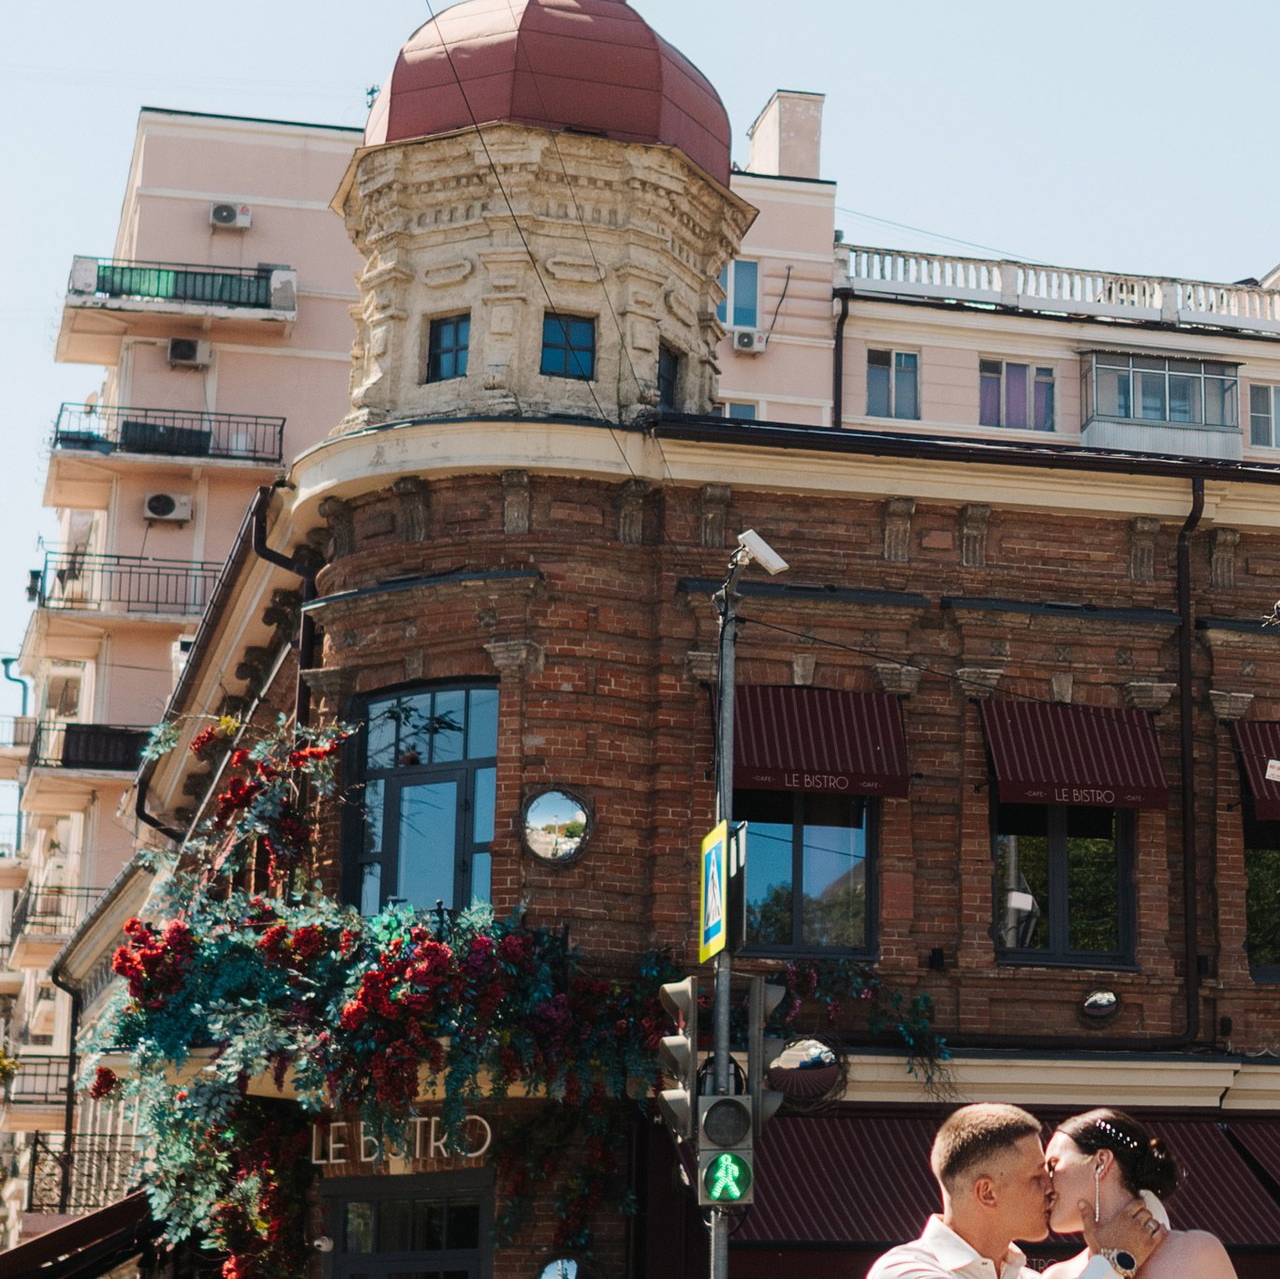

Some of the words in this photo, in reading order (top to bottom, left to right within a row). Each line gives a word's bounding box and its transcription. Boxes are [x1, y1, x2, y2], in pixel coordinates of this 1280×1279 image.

[784, 773, 800, 787] LE
[804, 774, 849, 790] BISTRO
[1054, 788, 1069, 802] LE
[1072, 789, 1115, 803] BISTRO
[312, 1122, 346, 1164] LE
